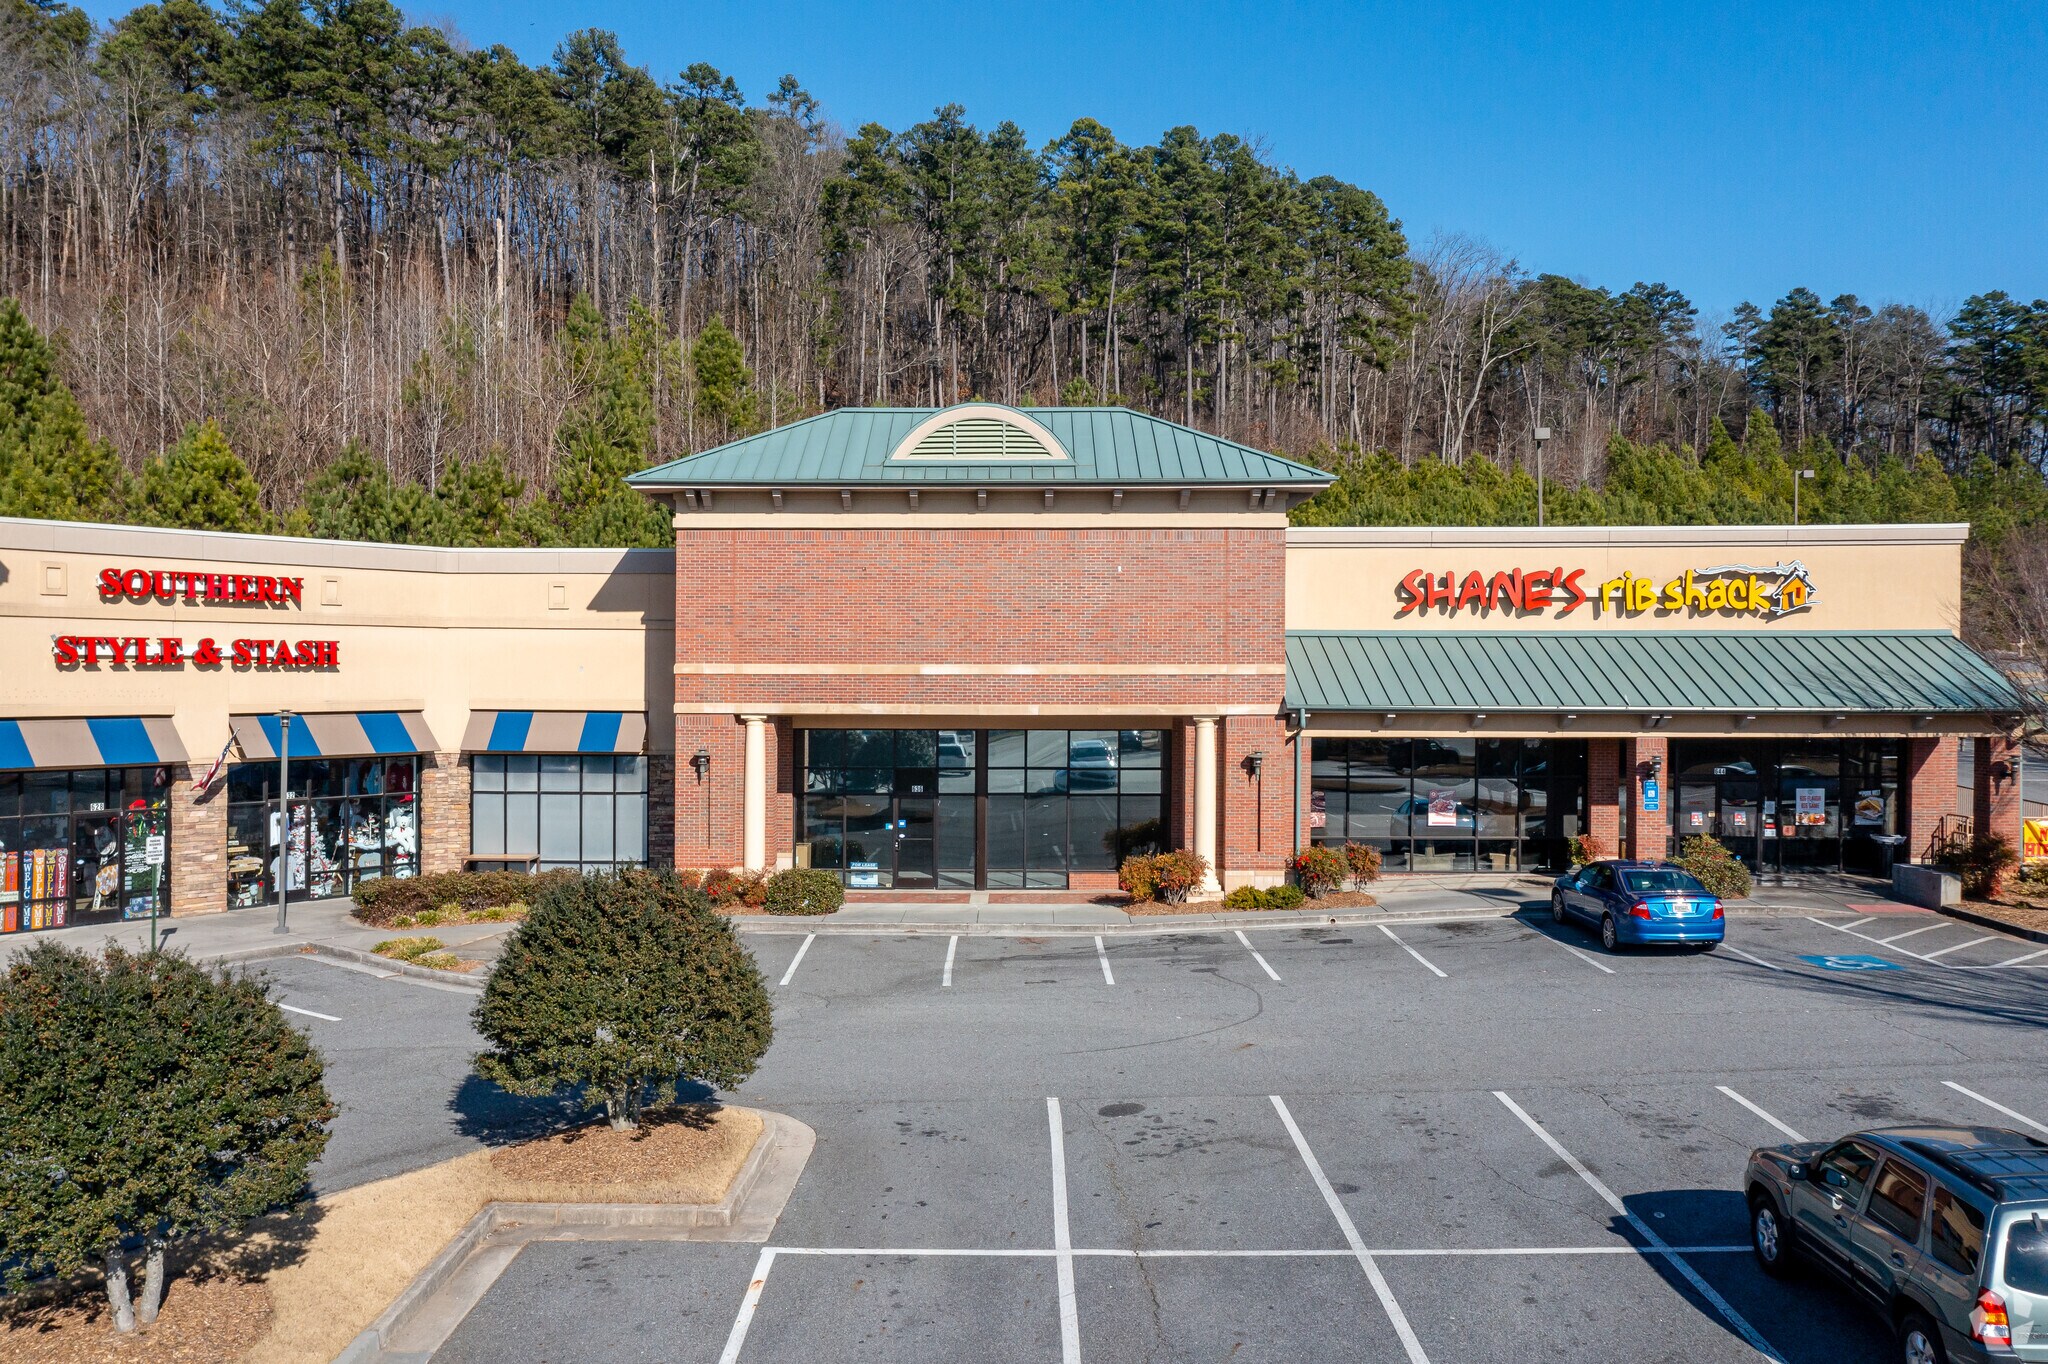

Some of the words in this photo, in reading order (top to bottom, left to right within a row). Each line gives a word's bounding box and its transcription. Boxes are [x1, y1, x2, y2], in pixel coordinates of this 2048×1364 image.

[100, 568, 304, 608] SOUTHERN
[1401, 566, 1586, 612] SHANE'S
[55, 635, 184, 664] STYLE
[193, 637, 223, 665] &
[232, 638, 341, 666] STASH
